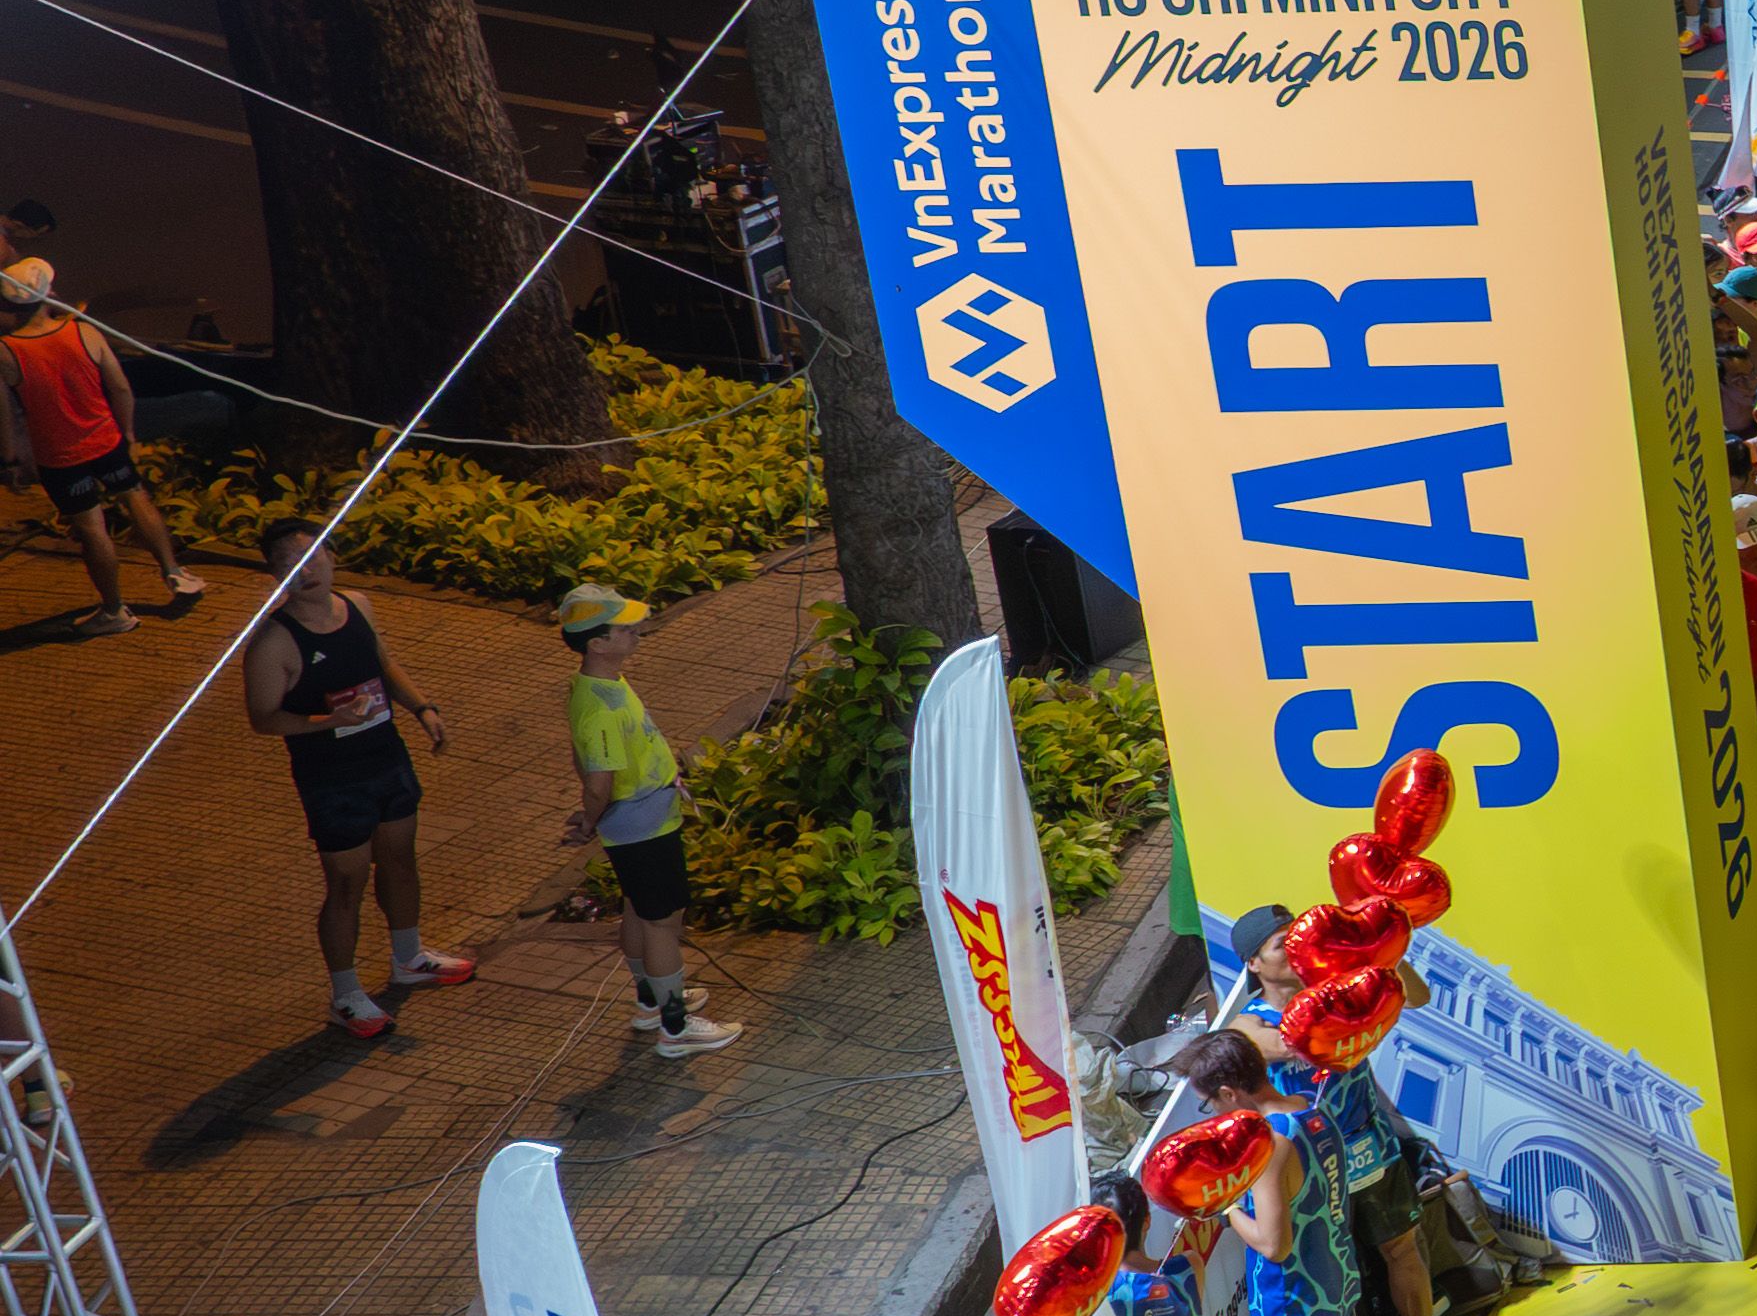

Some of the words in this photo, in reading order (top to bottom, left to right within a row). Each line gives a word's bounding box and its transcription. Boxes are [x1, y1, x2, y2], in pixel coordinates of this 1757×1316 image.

[1093, 25, 1379, 108] Midnight
[1391, 20, 1529, 82] 2026
[1635, 145, 1652, 206] HO
[1643, 209, 1661, 281] CHI
[1651, 279, 1676, 387] MINH
[1650, 124, 1695, 408] VNEXPRESS
[1684, 405, 1726, 668] MARATHON
[1664, 386, 1685, 466] CITY
[1175, 148, 1562, 811] START
[1702, 669, 1752, 920] 2026
[1335, 1023, 1385, 1056] HM
[1202, 1165, 1252, 1203] HM
